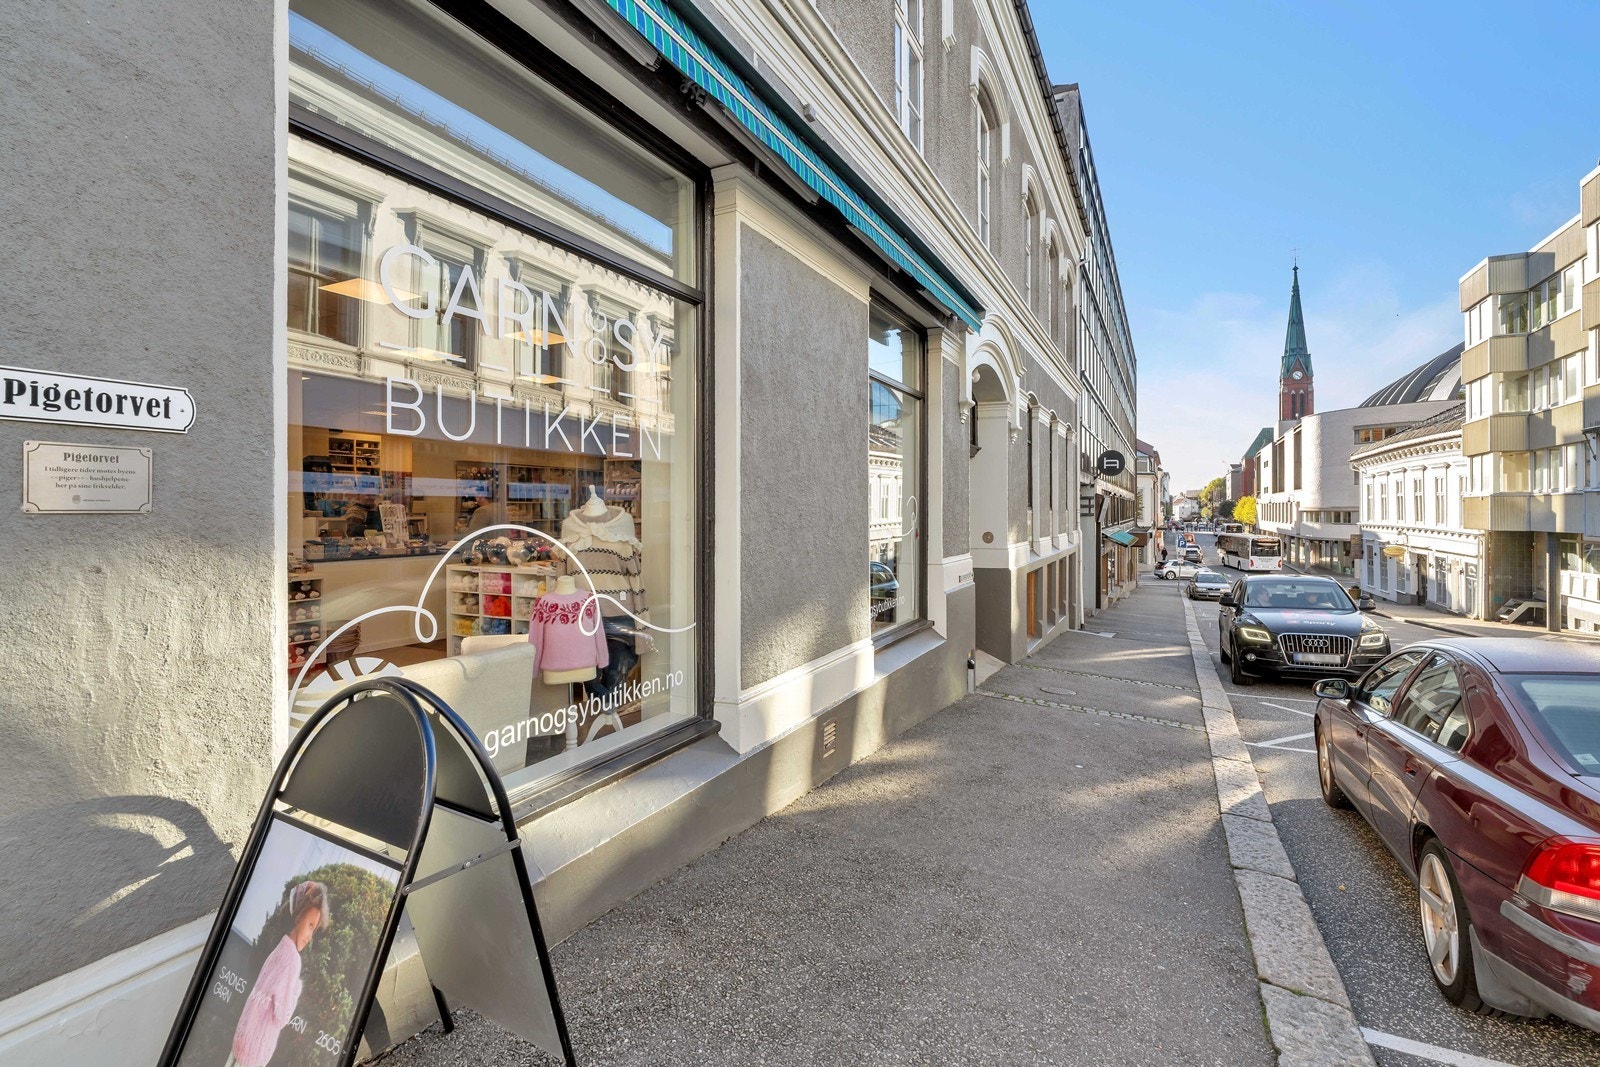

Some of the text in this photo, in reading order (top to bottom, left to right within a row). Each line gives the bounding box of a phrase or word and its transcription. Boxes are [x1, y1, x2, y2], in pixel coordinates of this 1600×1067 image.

[380, 244, 580, 358] GARN
[612, 318, 664, 377] SY
[3, 378, 172, 420] Pigetorvet
[386, 376, 661, 460] BUTIKKEN
[63, 452, 119, 464] Pigetorvet
[484, 670, 684, 759] garnogsybutikken.no
[213, 981, 233, 1003] GARN
[315, 1030, 342, 1056] 2605
